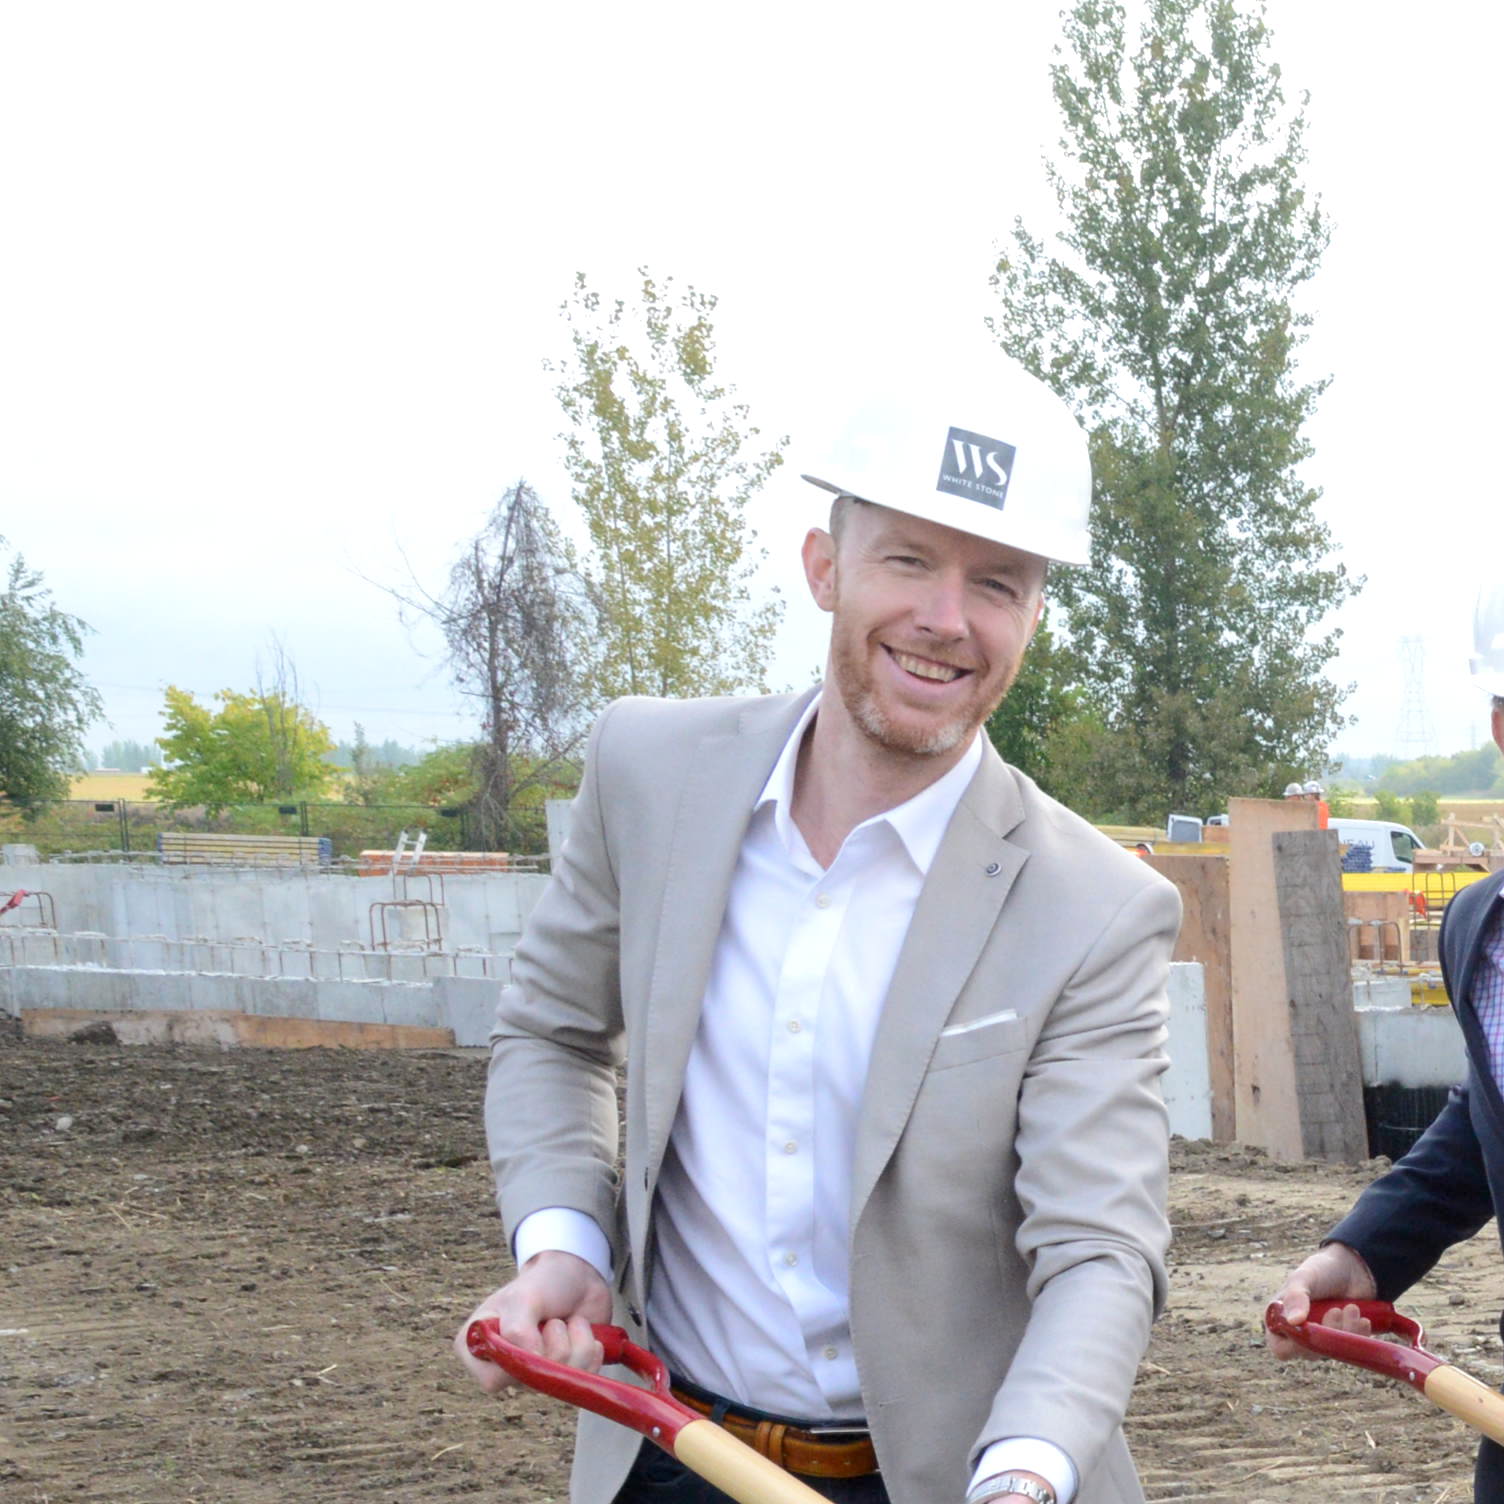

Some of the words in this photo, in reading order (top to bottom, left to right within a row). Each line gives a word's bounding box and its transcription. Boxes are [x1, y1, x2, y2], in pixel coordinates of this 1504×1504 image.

[952, 439, 1007, 486] WS
[942, 474, 973, 488] WHITE
[975, 484, 1004, 499] STONE
